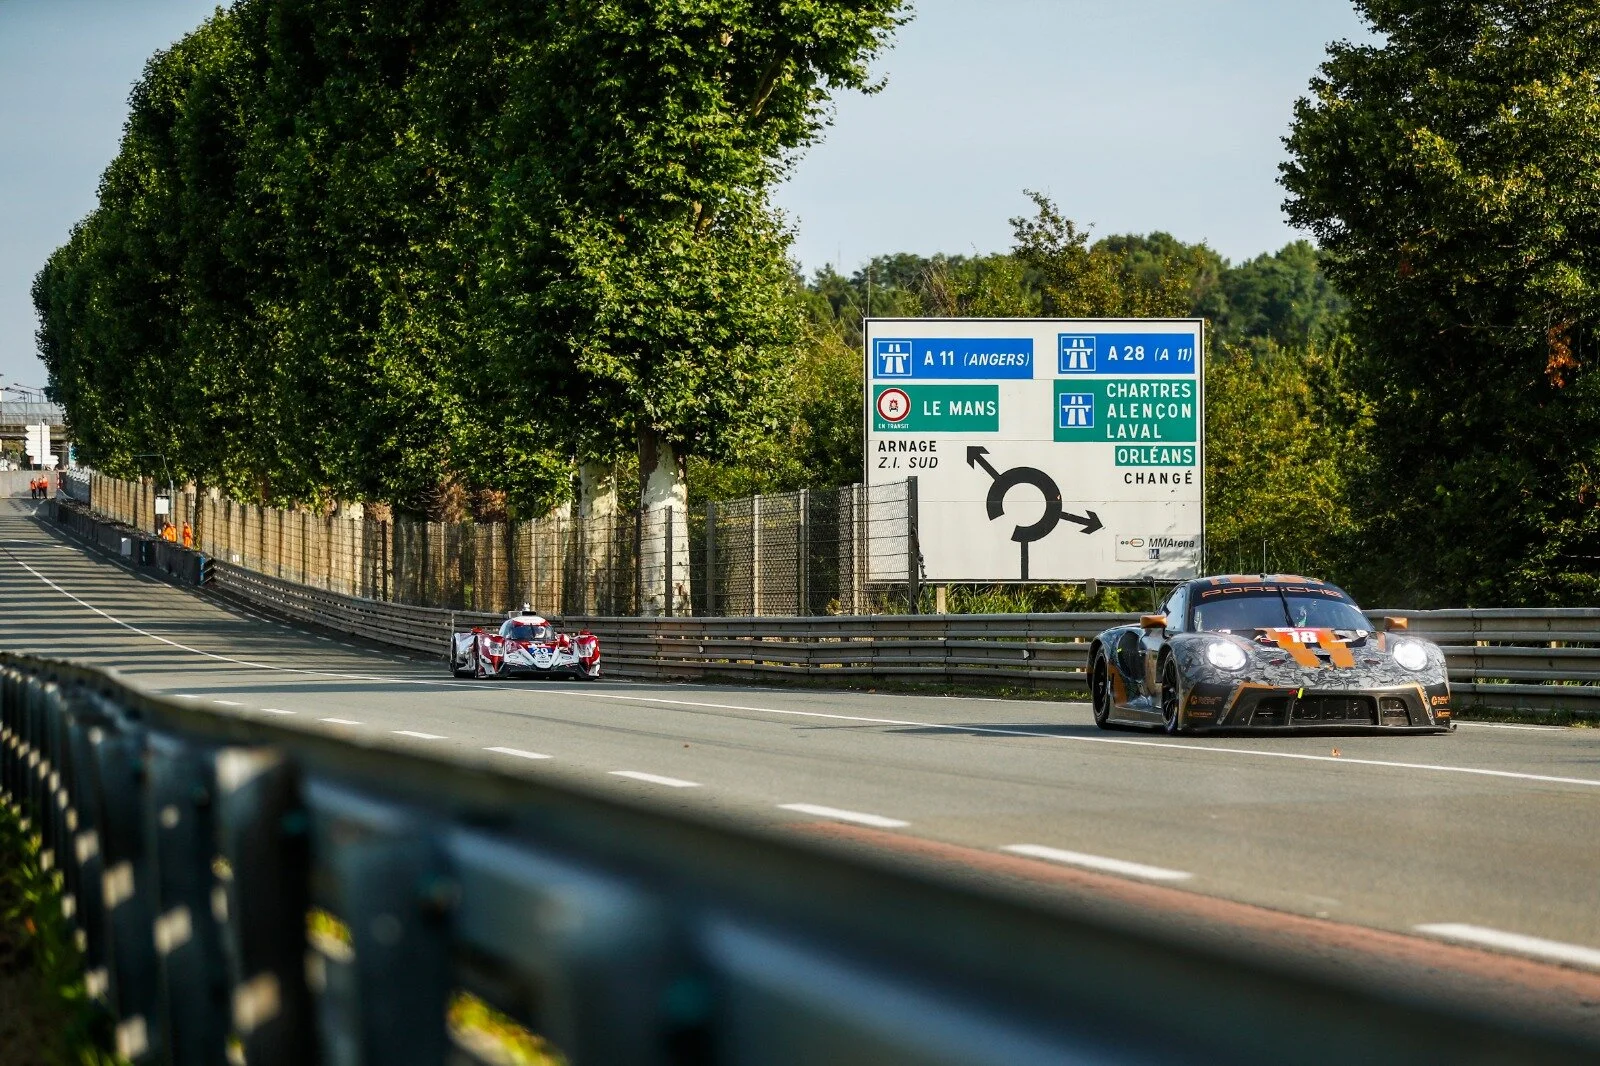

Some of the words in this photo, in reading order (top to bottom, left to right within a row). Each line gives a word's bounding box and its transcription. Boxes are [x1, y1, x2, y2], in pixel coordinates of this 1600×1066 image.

[924, 351, 934, 366] A
[939, 351, 954, 366] 11
[963, 352, 1030, 367] (ANGERS)
[1108, 345, 1119, 361] A
[1123, 345, 1145, 361] 28
[1154, 347, 1169, 362] (A
[1177, 347, 1192, 362] 11)
[1106, 382, 1192, 398] CHARTRES
[923, 400, 942, 416] LE
[949, 400, 996, 416] MANS
[1107, 403, 1192, 420] ALENÇON
[1106, 423, 1162, 439] LAVAL
[878, 440, 937, 452] ARNAGE
[878, 456, 900, 469] Z.I.
[908, 456, 938, 469] SUD
[1117, 446, 1193, 464] ORLÉANS
[1124, 470, 1193, 484] CHANGÉ
[1148, 538, 1195, 548] MMArena
[1201, 586, 1344, 599] PORSCHE
[1287, 630, 1318, 643] 18
